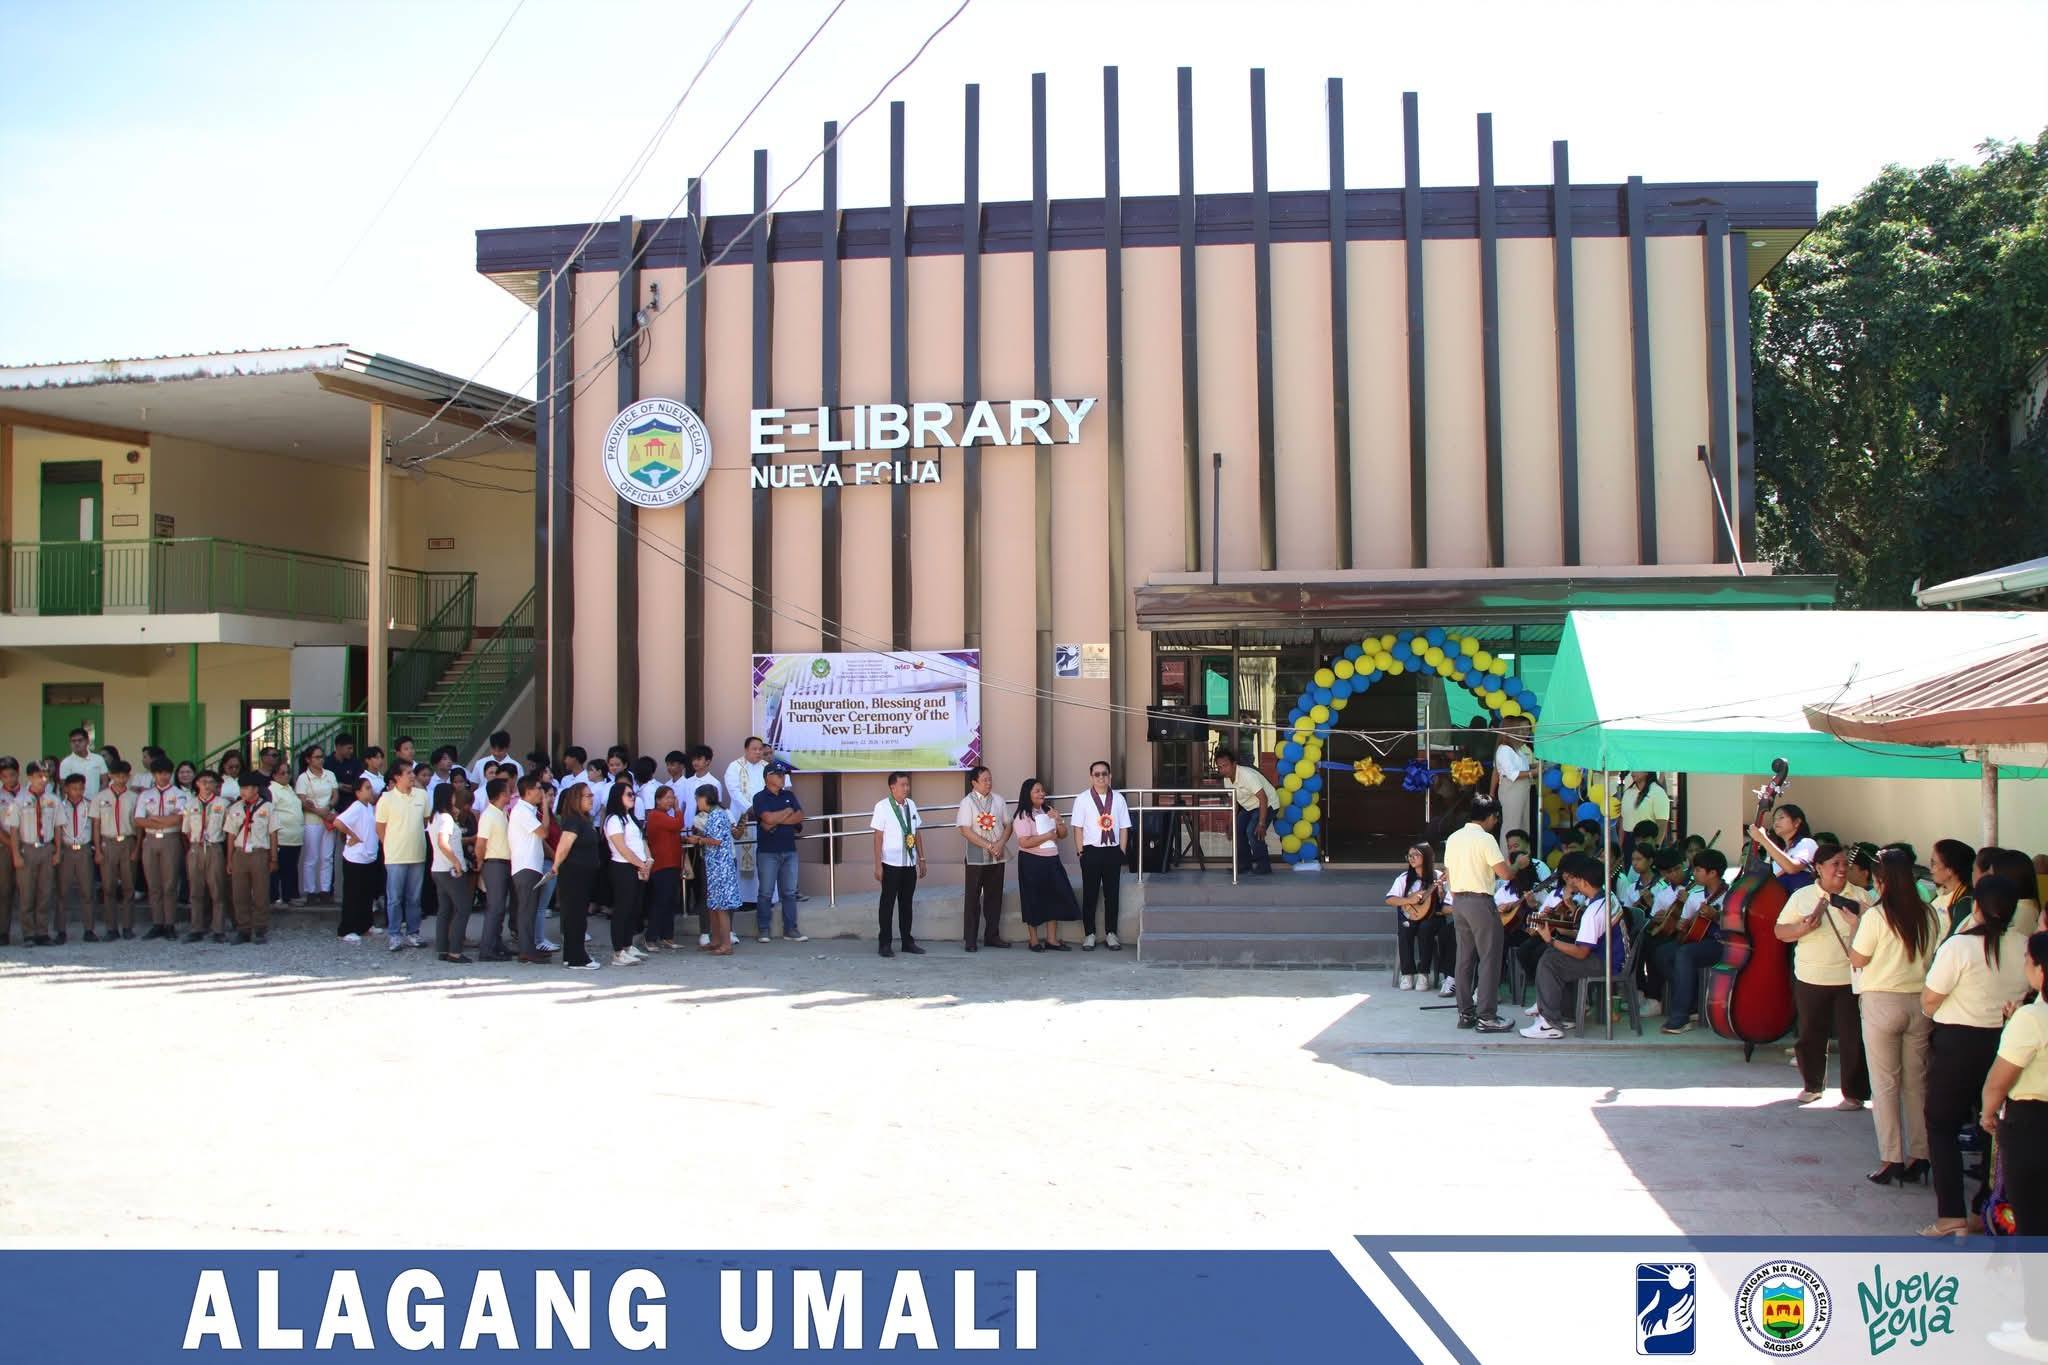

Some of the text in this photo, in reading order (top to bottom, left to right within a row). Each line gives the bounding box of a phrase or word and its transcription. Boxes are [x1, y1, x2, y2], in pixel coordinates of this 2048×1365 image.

[607, 403, 703, 460] PROVINCE OF NUEVA ECIJA
[750, 398, 1097, 454] E-LIBRARY
[750, 460, 941, 489] NUEVA ECIJA
[619, 479, 693, 503] OFFICIAL SEAL
[786, 709, 950, 724] Turnover Ceremony of the
[789, 696, 946, 713] Inauguration, Blessing and
[821, 723, 913, 737] New E-Library
